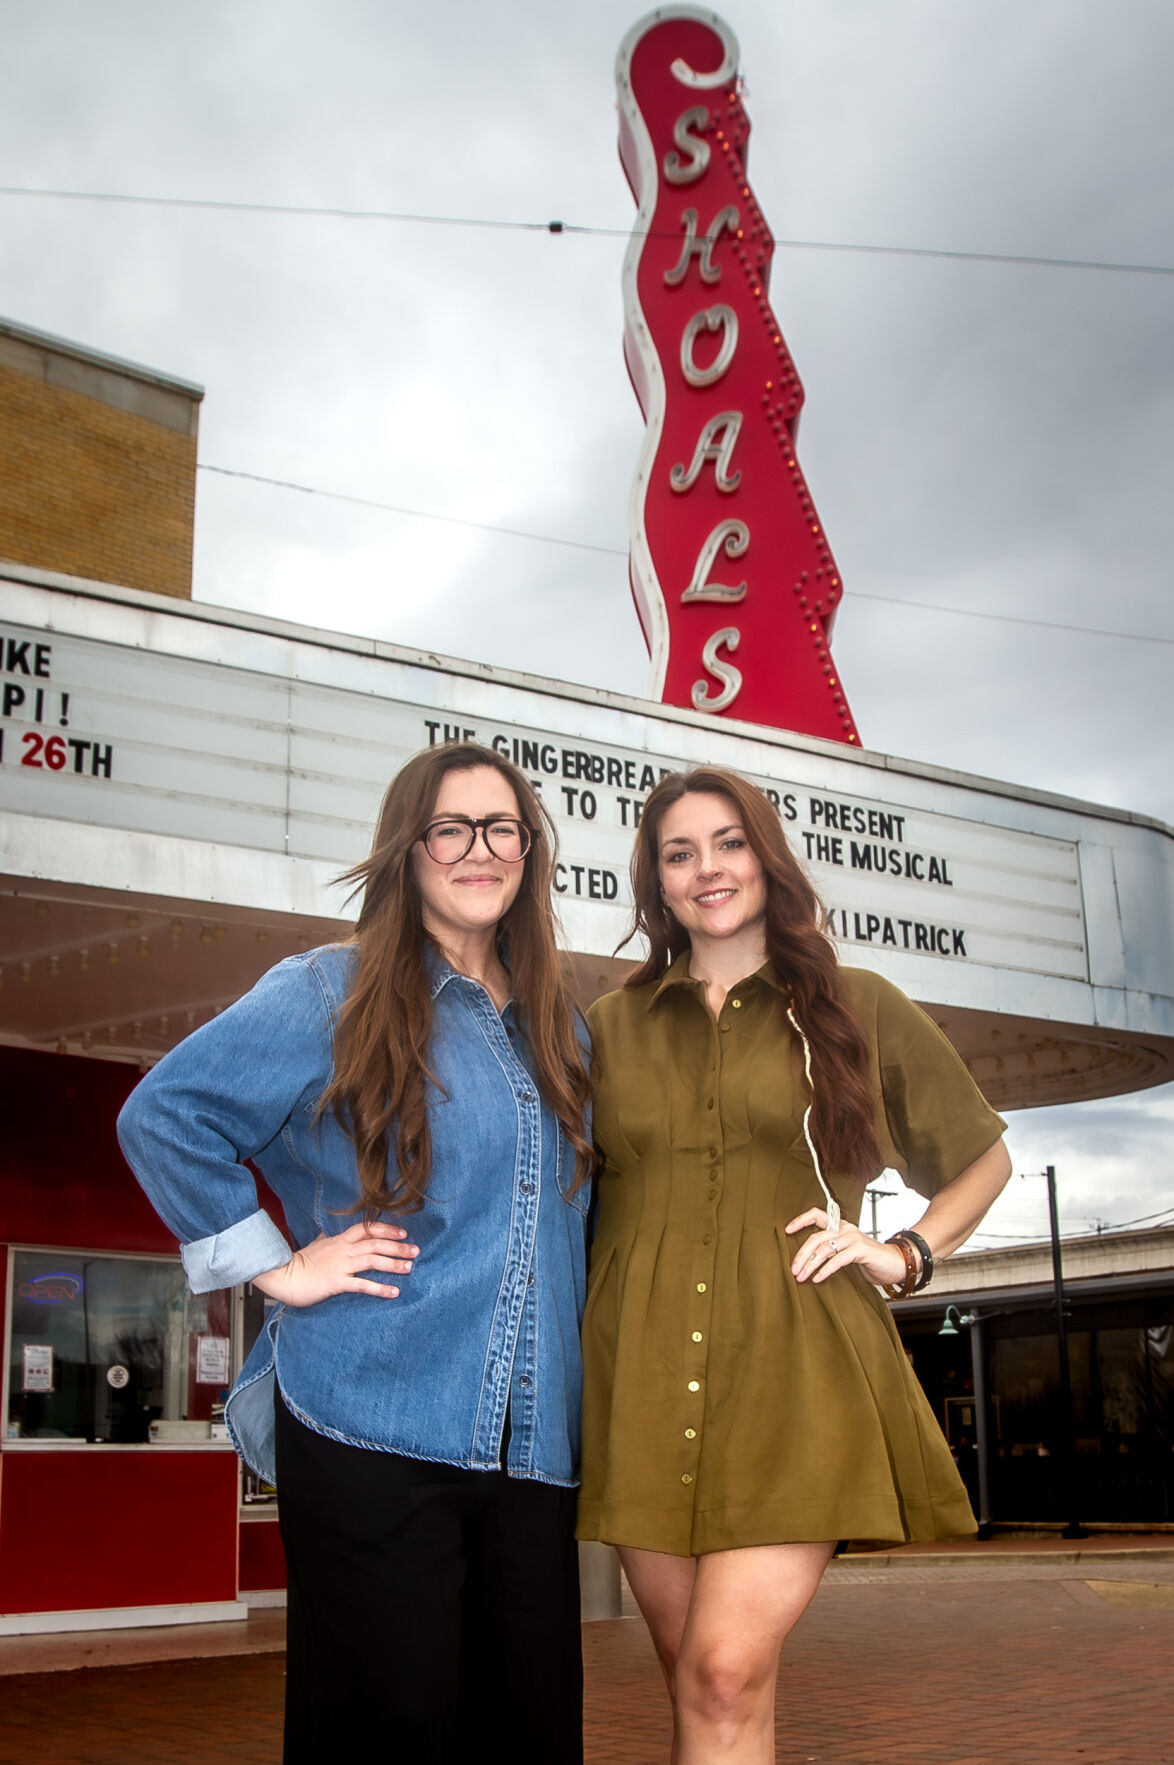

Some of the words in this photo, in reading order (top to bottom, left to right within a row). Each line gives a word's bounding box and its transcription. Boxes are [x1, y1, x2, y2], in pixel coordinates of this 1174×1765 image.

[663, 104, 750, 713] SHOALS
[21, 731, 113, 779] 26TH
[561, 786, 597, 820] TO
[802, 831, 844, 866] THE
[849, 840, 953, 886] MUSICAL
[758, 787, 798, 821] RS
[810, 797, 905, 843] PRESENT
[823, 907, 967, 957] KILPATRICK
[18, 1282, 75, 1300] OPEN
